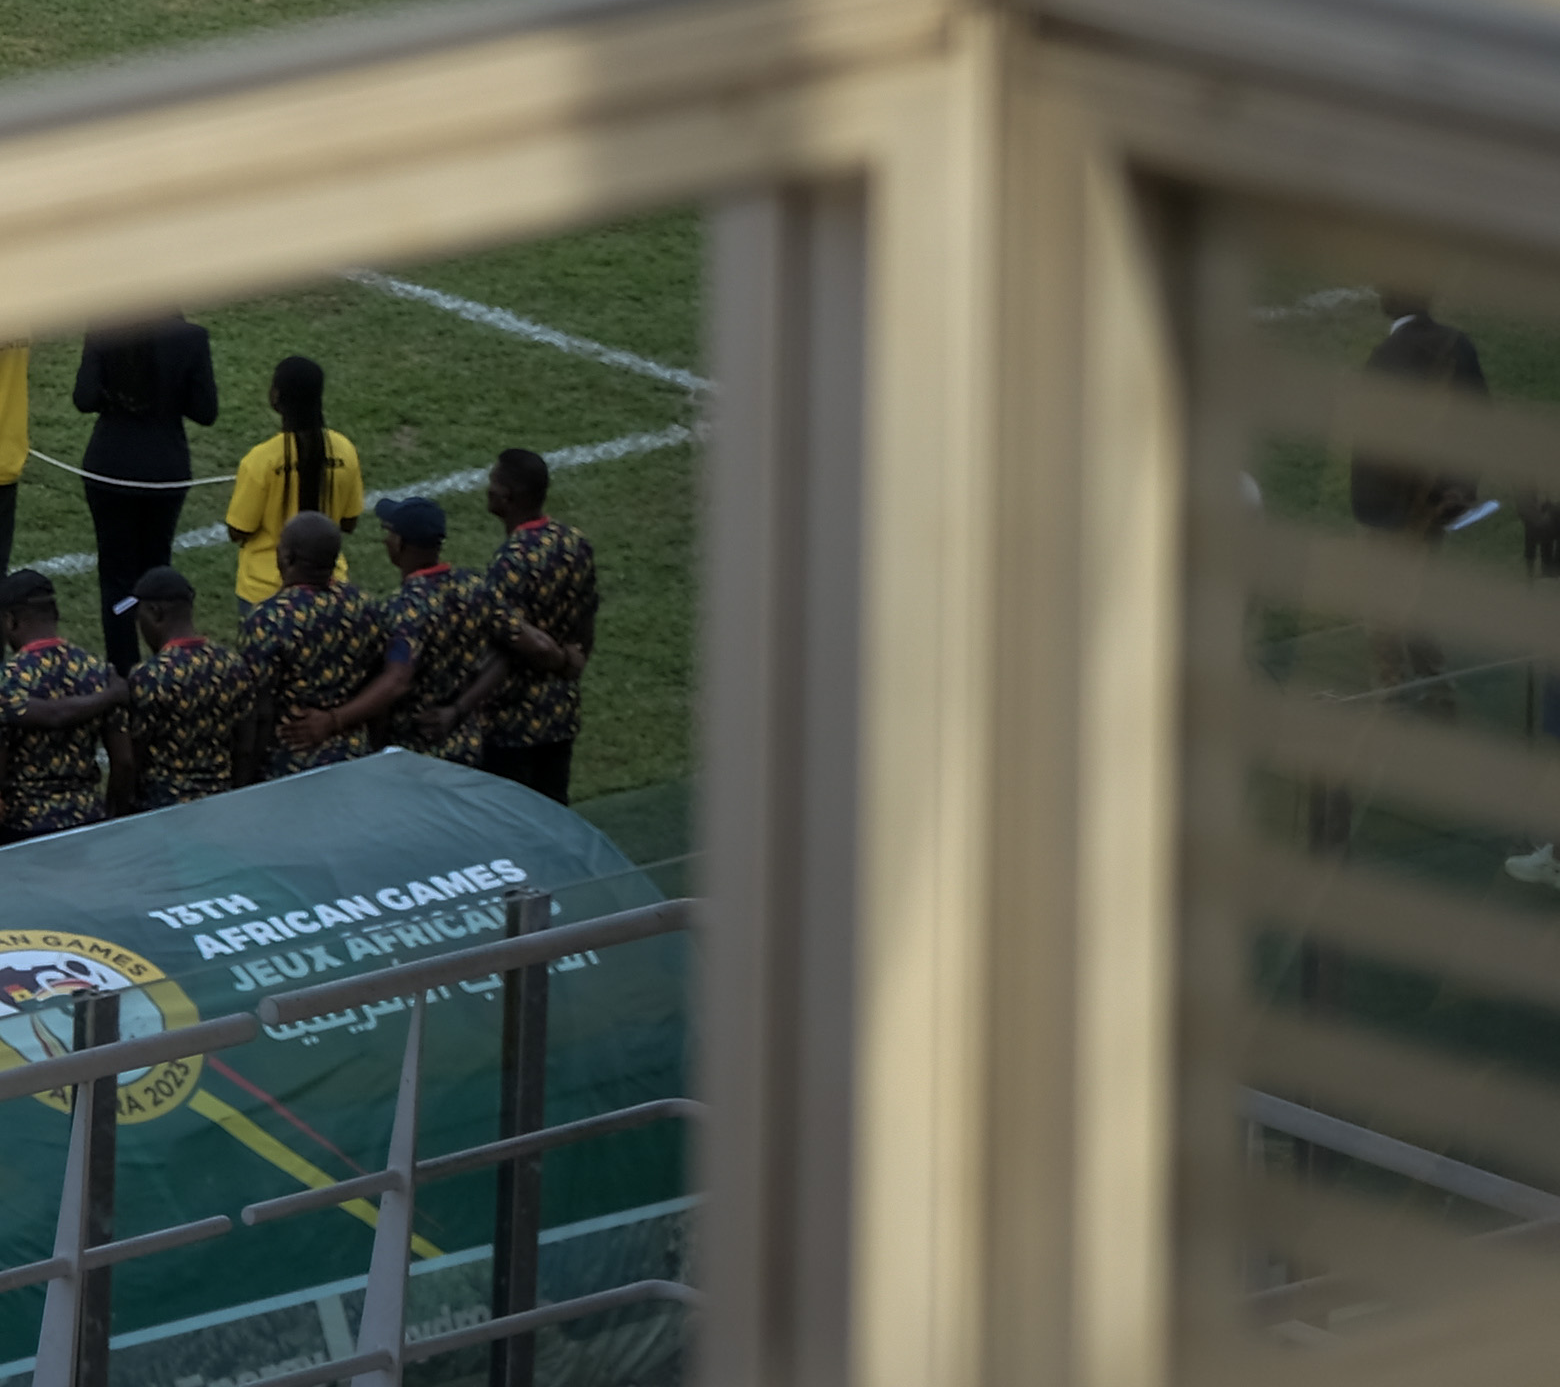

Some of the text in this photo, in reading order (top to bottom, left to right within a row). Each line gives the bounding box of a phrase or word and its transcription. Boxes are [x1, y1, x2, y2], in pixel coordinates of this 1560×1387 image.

[148, 892, 261, 929] 13TH
[193, 858, 528, 961] AFRICAN GAMES
[42, 934, 149, 977] GAMES
[230, 944, 343, 992] JEUX
[142, 1059, 192, 1107] 2023
